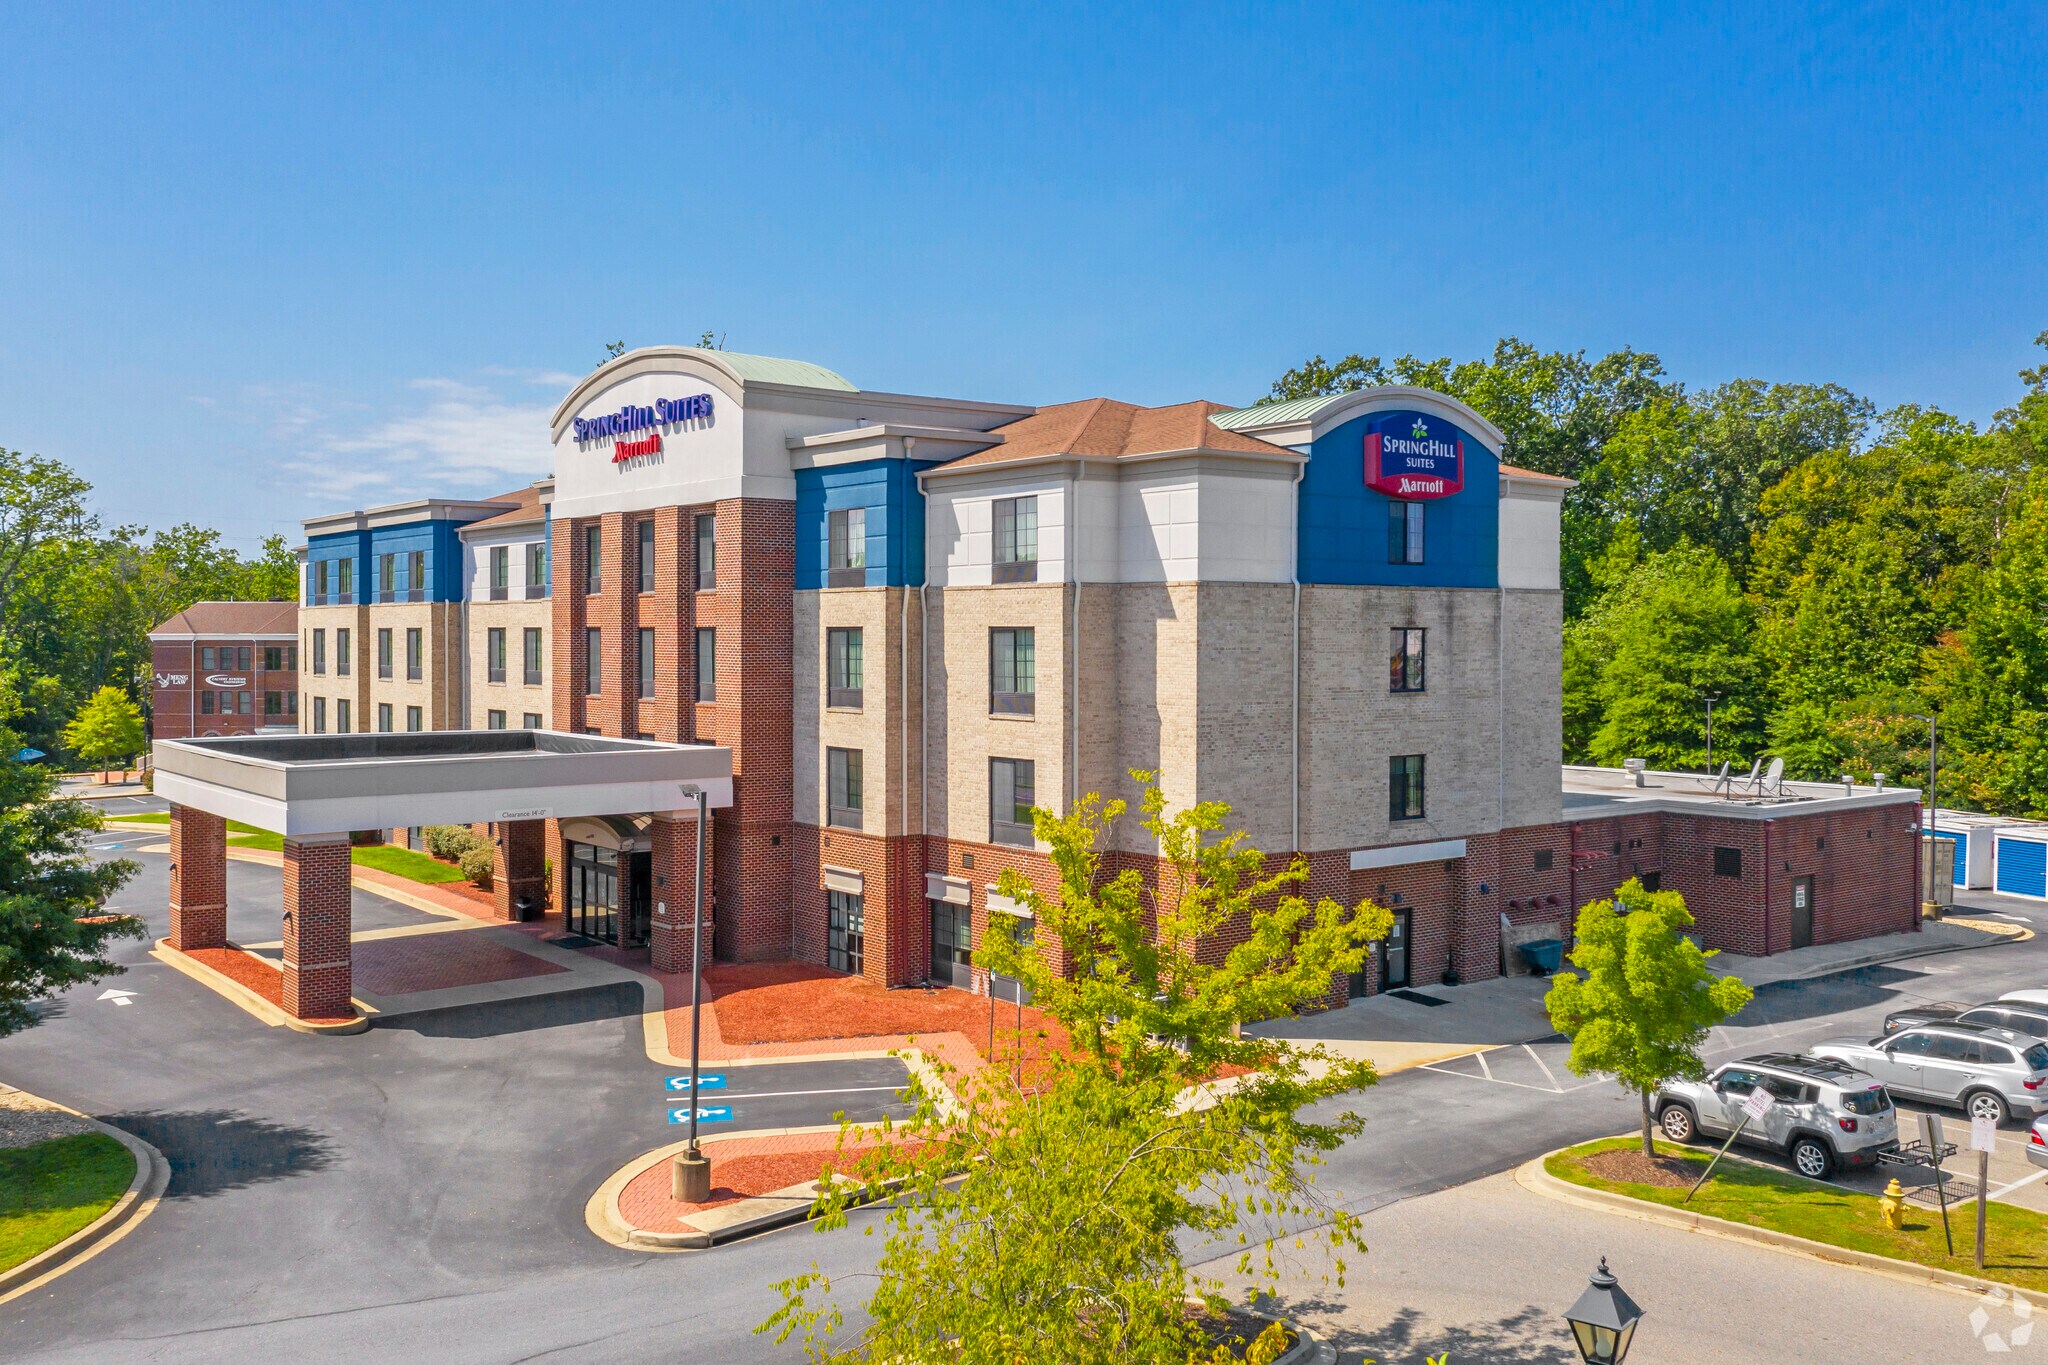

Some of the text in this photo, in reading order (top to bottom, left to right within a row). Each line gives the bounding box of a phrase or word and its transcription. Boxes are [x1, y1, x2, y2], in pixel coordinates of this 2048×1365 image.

[573, 393, 713, 443] SPRINGHILL SUITES
[611, 434, 662, 463] Marriott
[1383, 435, 1455, 457] SPRINGHILL
[1406, 457, 1435, 469] SUITES
[1398, 477, 1444, 494] Marriott
